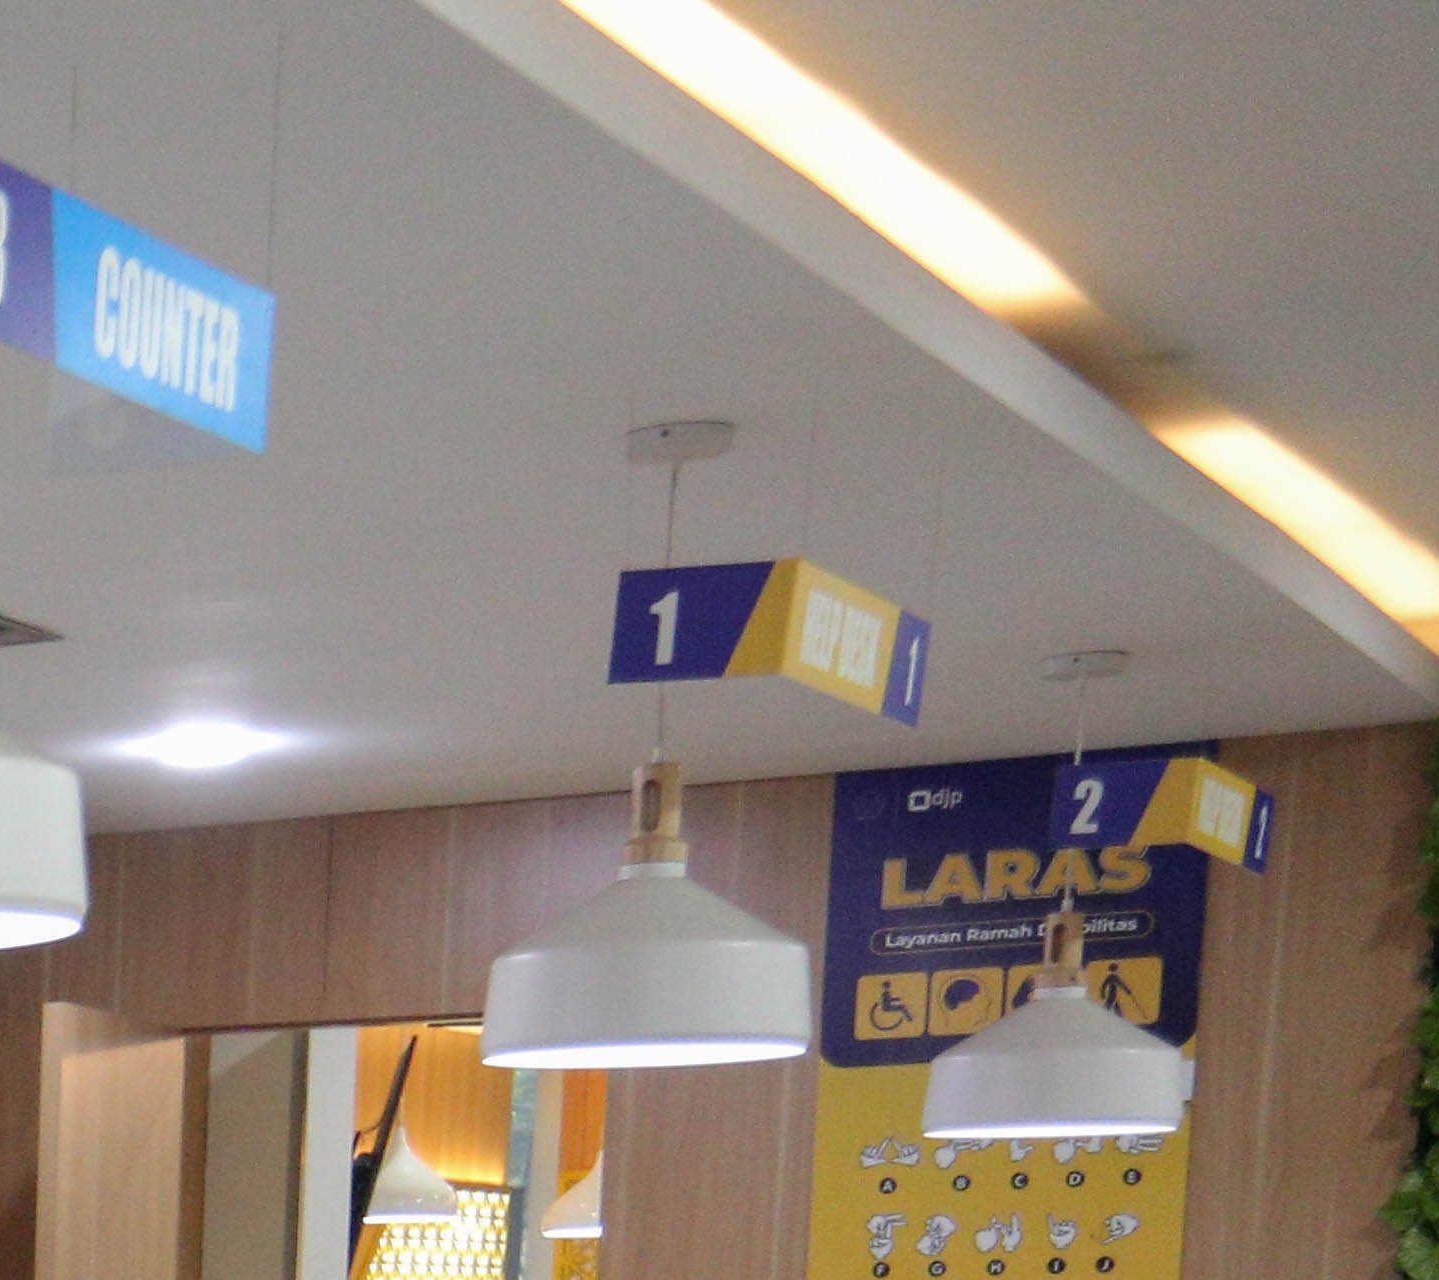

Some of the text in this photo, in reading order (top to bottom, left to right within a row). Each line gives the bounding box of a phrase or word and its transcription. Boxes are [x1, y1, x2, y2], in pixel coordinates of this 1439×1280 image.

[94, 245, 241, 414] COUNTER
[649, 591, 679, 666] 1
[904, 637, 919, 707] 1
[930, 788, 962, 810] djp
[1070, 779, 1104, 834] 2
[880, 845, 1153, 910] LARAS
[884, 930, 962, 950] Layanan
[967, 925, 1032, 943] Ramah
